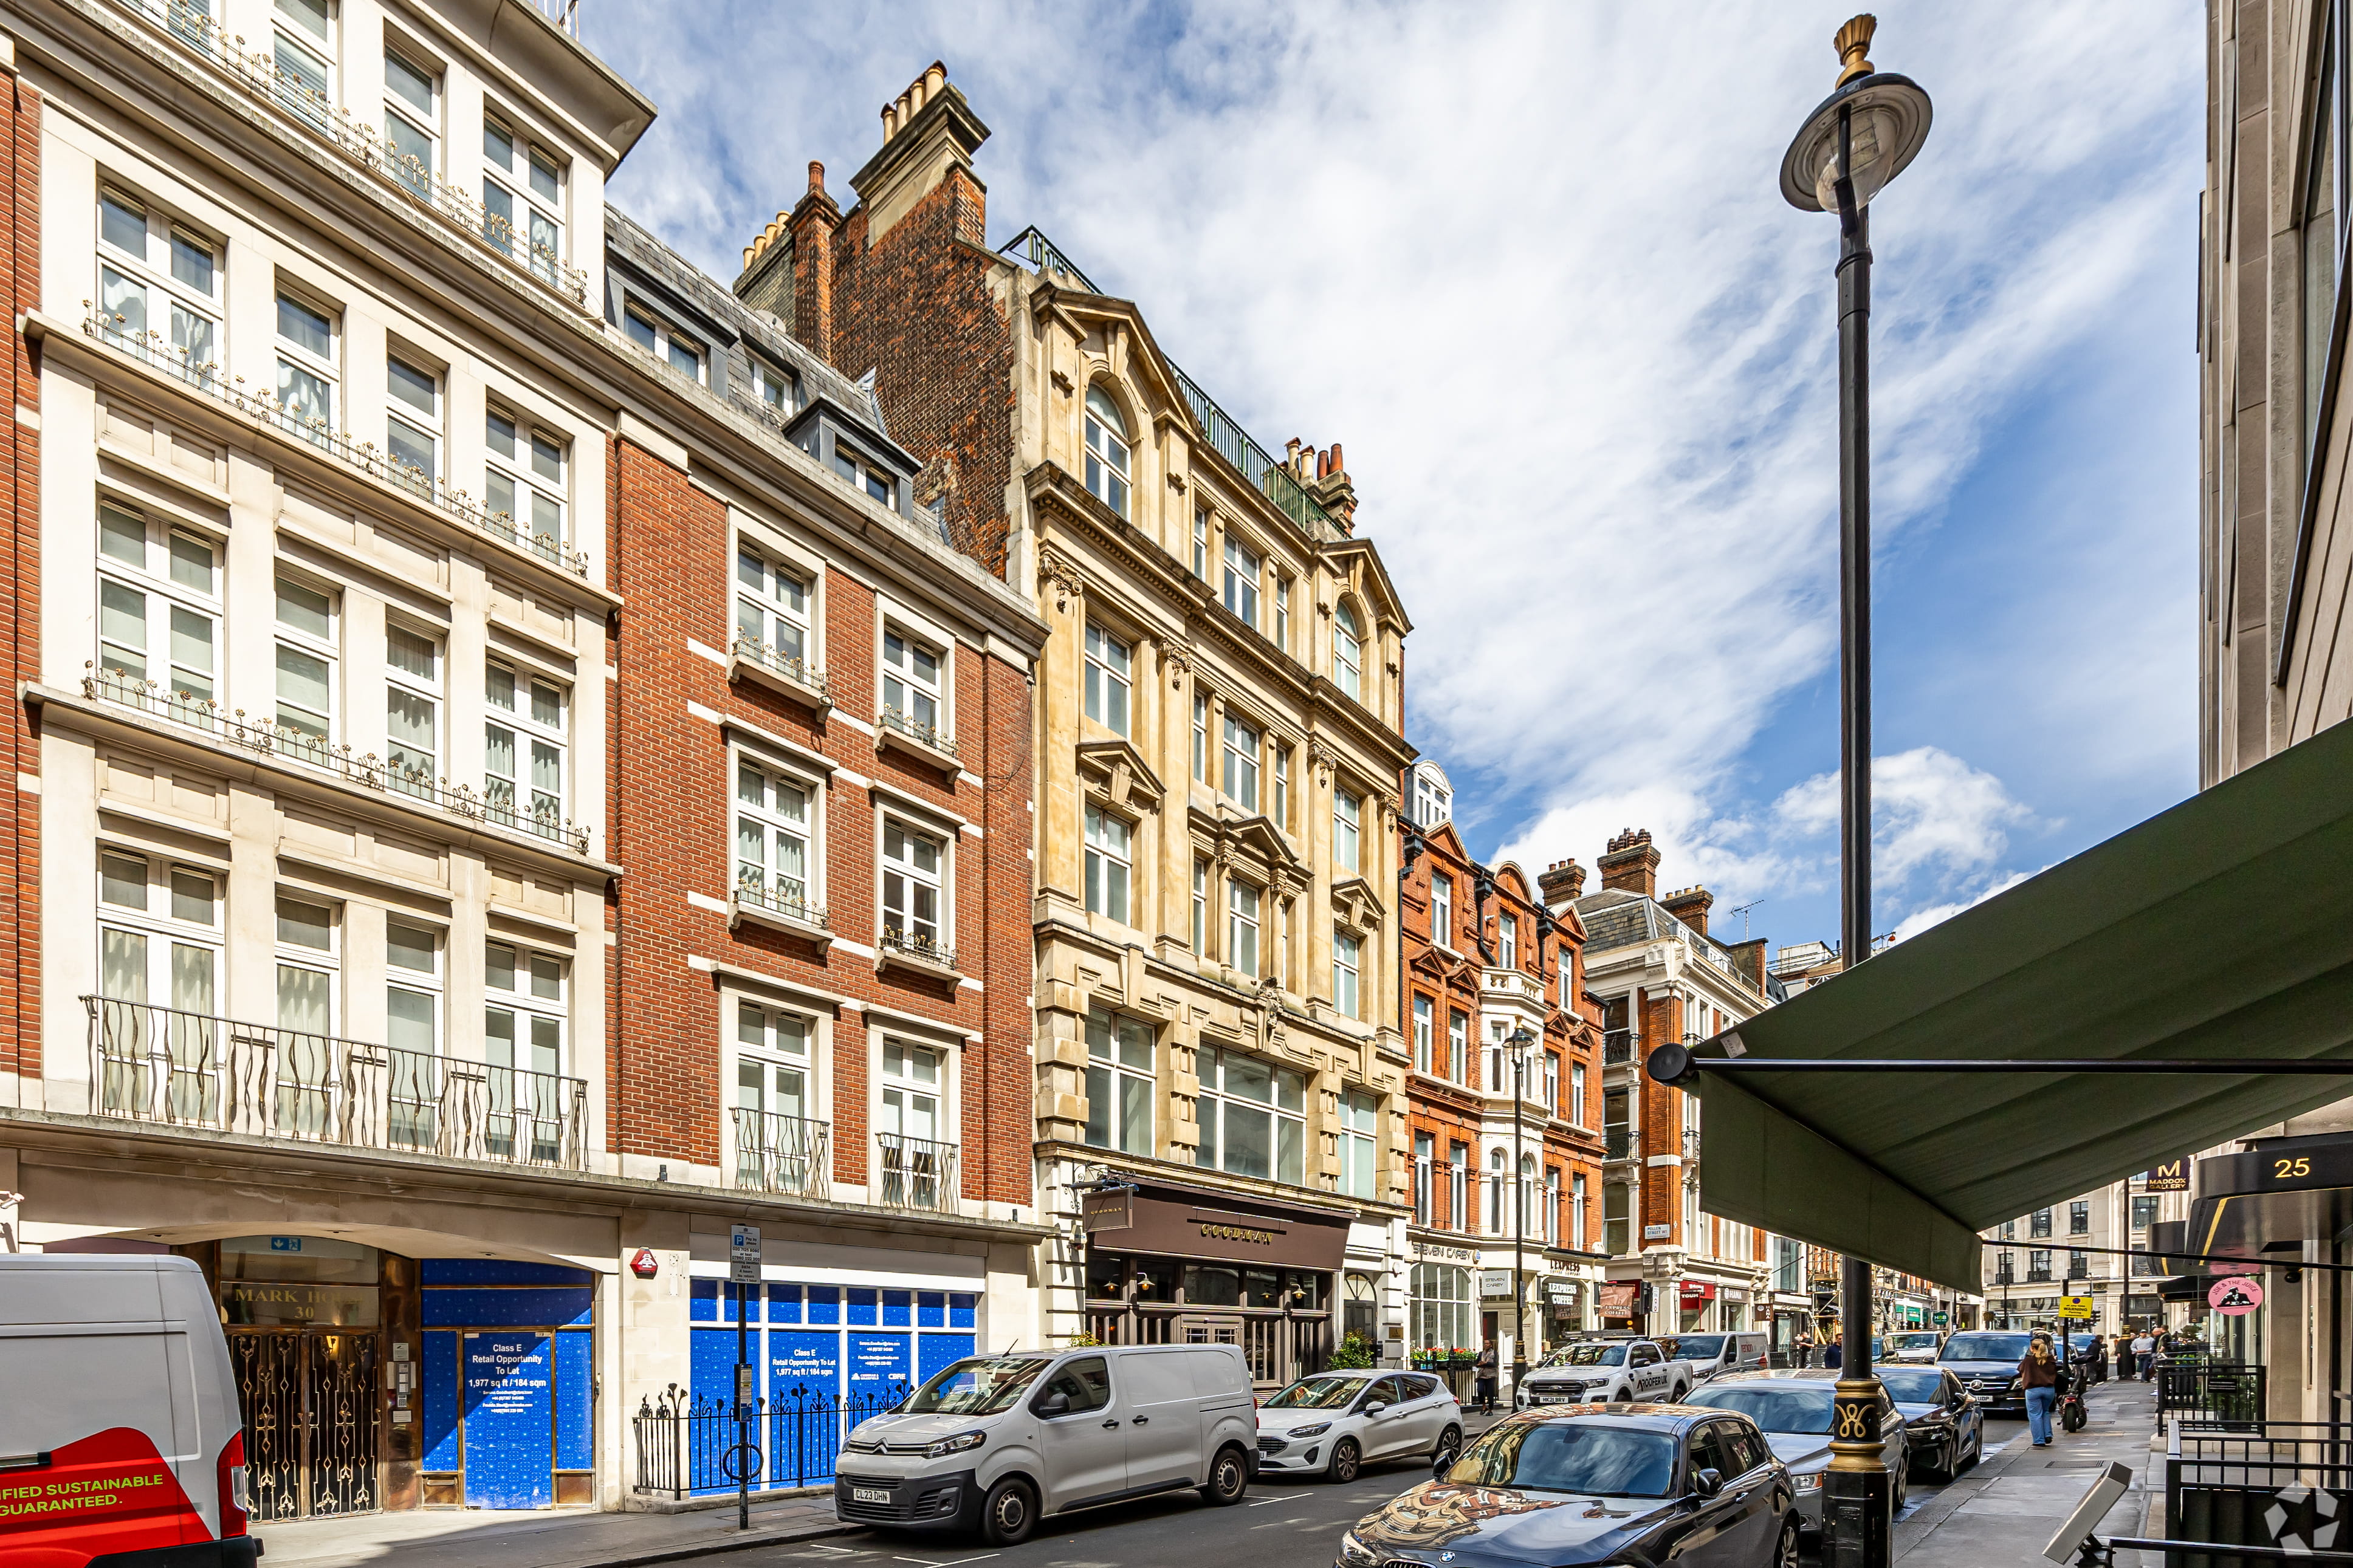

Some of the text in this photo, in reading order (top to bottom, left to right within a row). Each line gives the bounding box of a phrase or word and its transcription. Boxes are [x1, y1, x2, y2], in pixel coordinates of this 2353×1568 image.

[2157, 1160, 2180, 1177] M
[2275, 1157, 2310, 1178] 25
[1201, 1224, 1274, 1243] GOODMAN
[737, 1236, 743, 1245] P
[1413, 1243, 1444, 1257] STEVEN
[1446, 1247, 1472, 1261] CAREY
[1729, 1290, 1742, 1299] HANA
[2212, 1286, 2222, 1295] JOE
[2242, 1282, 2259, 1293] JUICE
[235, 1289, 298, 1303] MARK
[1551, 1294, 1574, 1306] COFFEE
[294, 1306, 315, 1318] 30
[496, 1354, 543, 1364] Opportunity
[788, 1358, 820, 1367] Opportunity
[468, 1378, 489, 1388] 1,977
[502, 1378, 509, 1387] ft
[514, 1378, 528, 1387] 184
[529, 1380, 547, 1388] sqm
[1661, 1375, 1668, 1385] UK
[46, 1474, 163, 1496] SUSTAINABLE
[856, 1490, 888, 1502] CL23 DHN
[0, 1494, 123, 1517] GUARANTEED.
